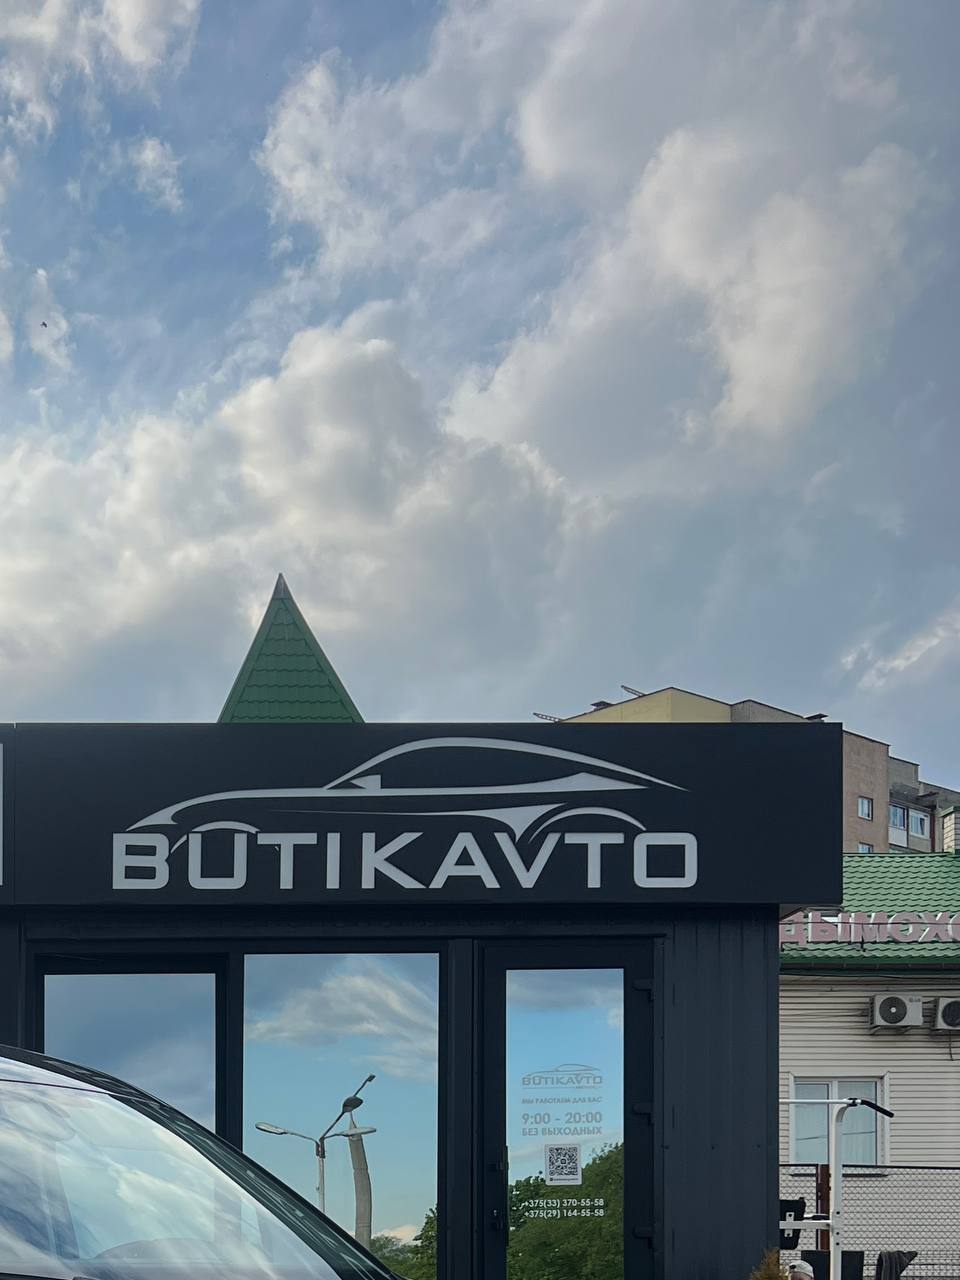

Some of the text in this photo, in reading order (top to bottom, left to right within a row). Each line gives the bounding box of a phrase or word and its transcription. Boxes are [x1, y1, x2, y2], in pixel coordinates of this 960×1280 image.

[111, 831, 699, 890] BUTIKAVTO
[779, 911, 960, 946] ДЫМОХ
[521, 1075, 603, 1086] BUTIKAVTO
[522, 1113, 550, 1125] 9:00
[565, 1112, 603, 1124] 20:00
[522, 1127, 602, 1136] БЕЗ ВЫХОДНЫХ
[524, 1199, 605, 1208] +375(33) 370-55-58
[524, 1210, 560, 1219] +375(29)
